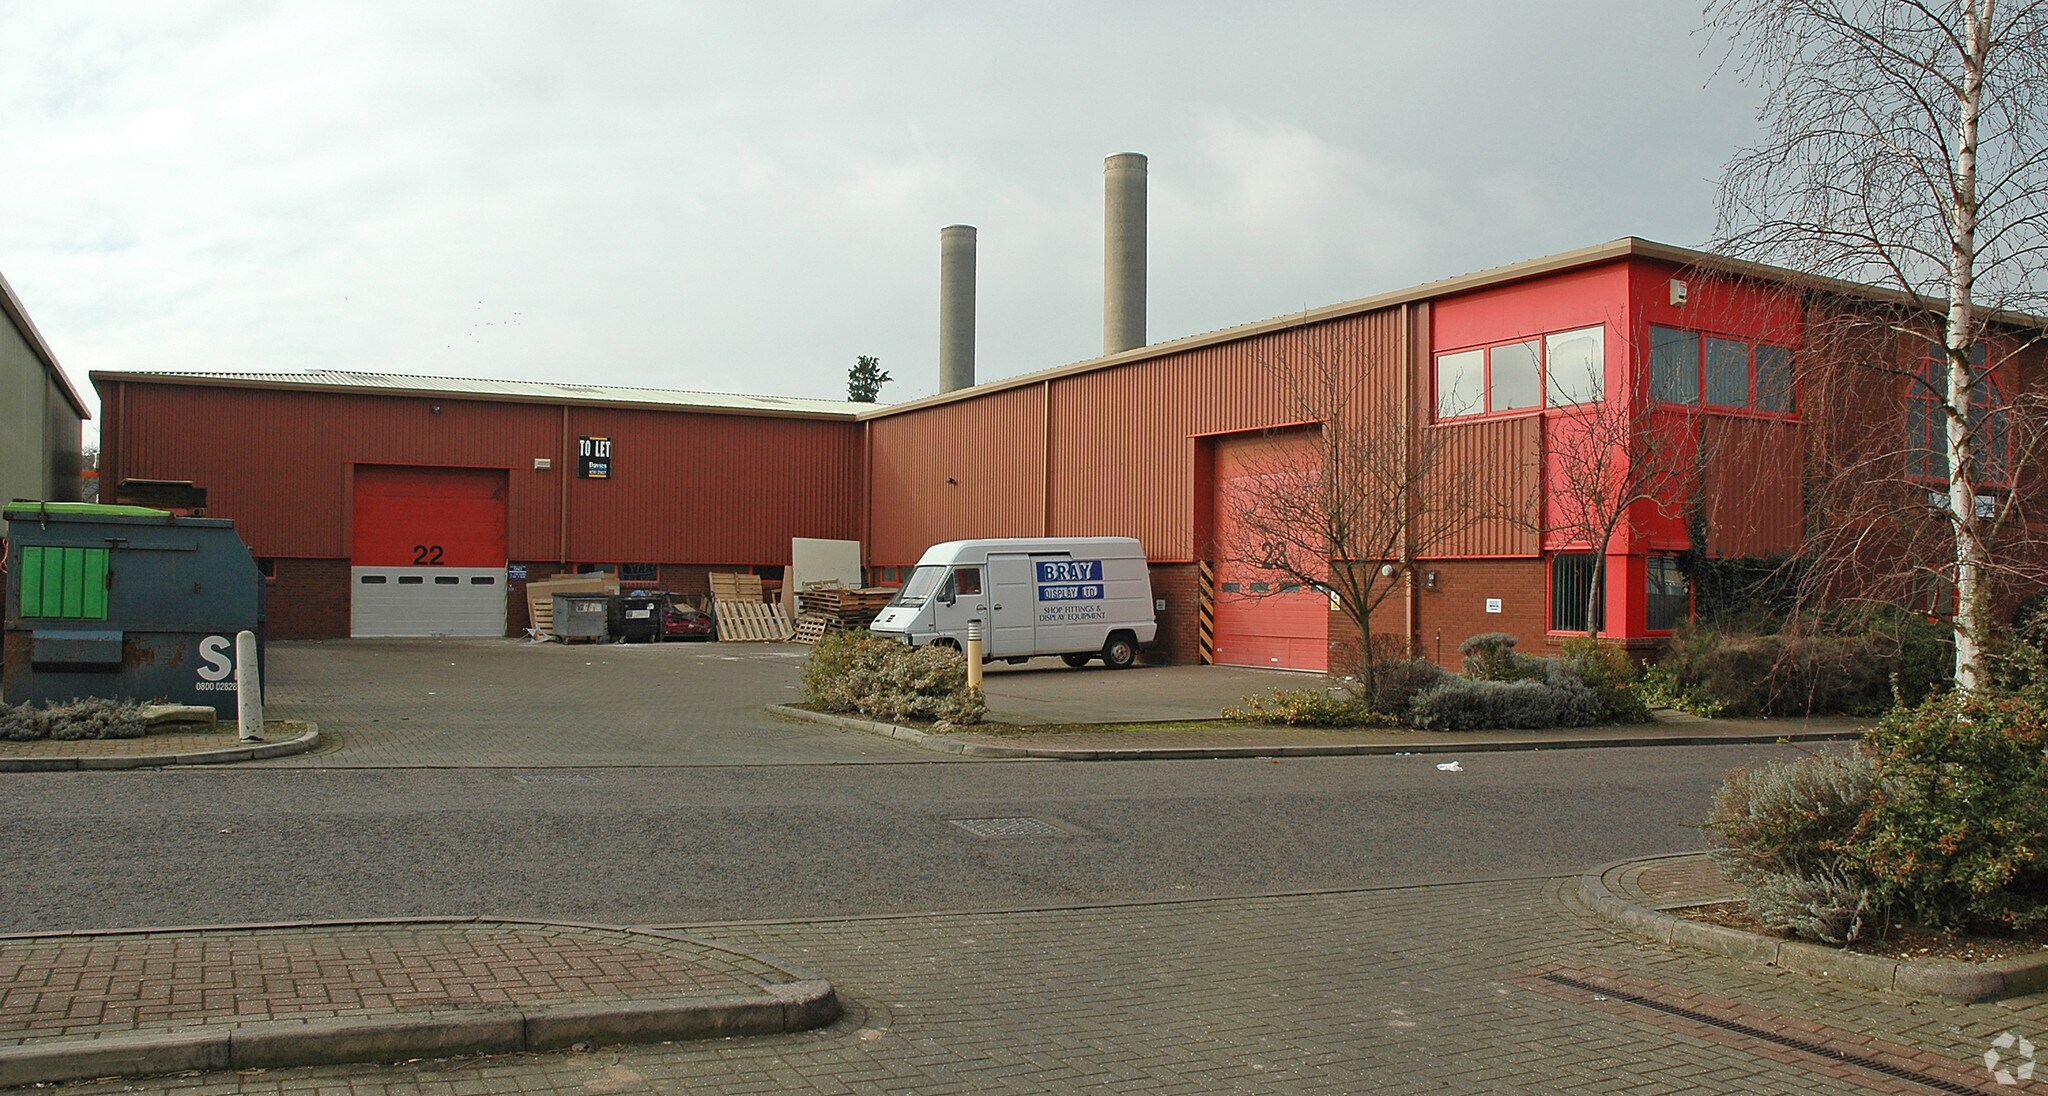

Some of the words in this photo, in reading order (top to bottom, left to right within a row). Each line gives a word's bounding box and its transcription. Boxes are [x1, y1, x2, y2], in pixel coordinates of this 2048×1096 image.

[580, 440, 591, 457] TO
[595, 441, 610, 457] LET
[413, 545, 444, 565] 22
[1044, 562, 1093, 580] BRAY
[1044, 586, 1078, 599] DISPLAY
[1044, 606, 1063, 614] SHOP
[1065, 605, 1094, 613] FITTINGS
[1068, 612, 1105, 621] EQUIPMENT
[197, 635, 238, 681] S
[196, 682, 214, 691] 0800
